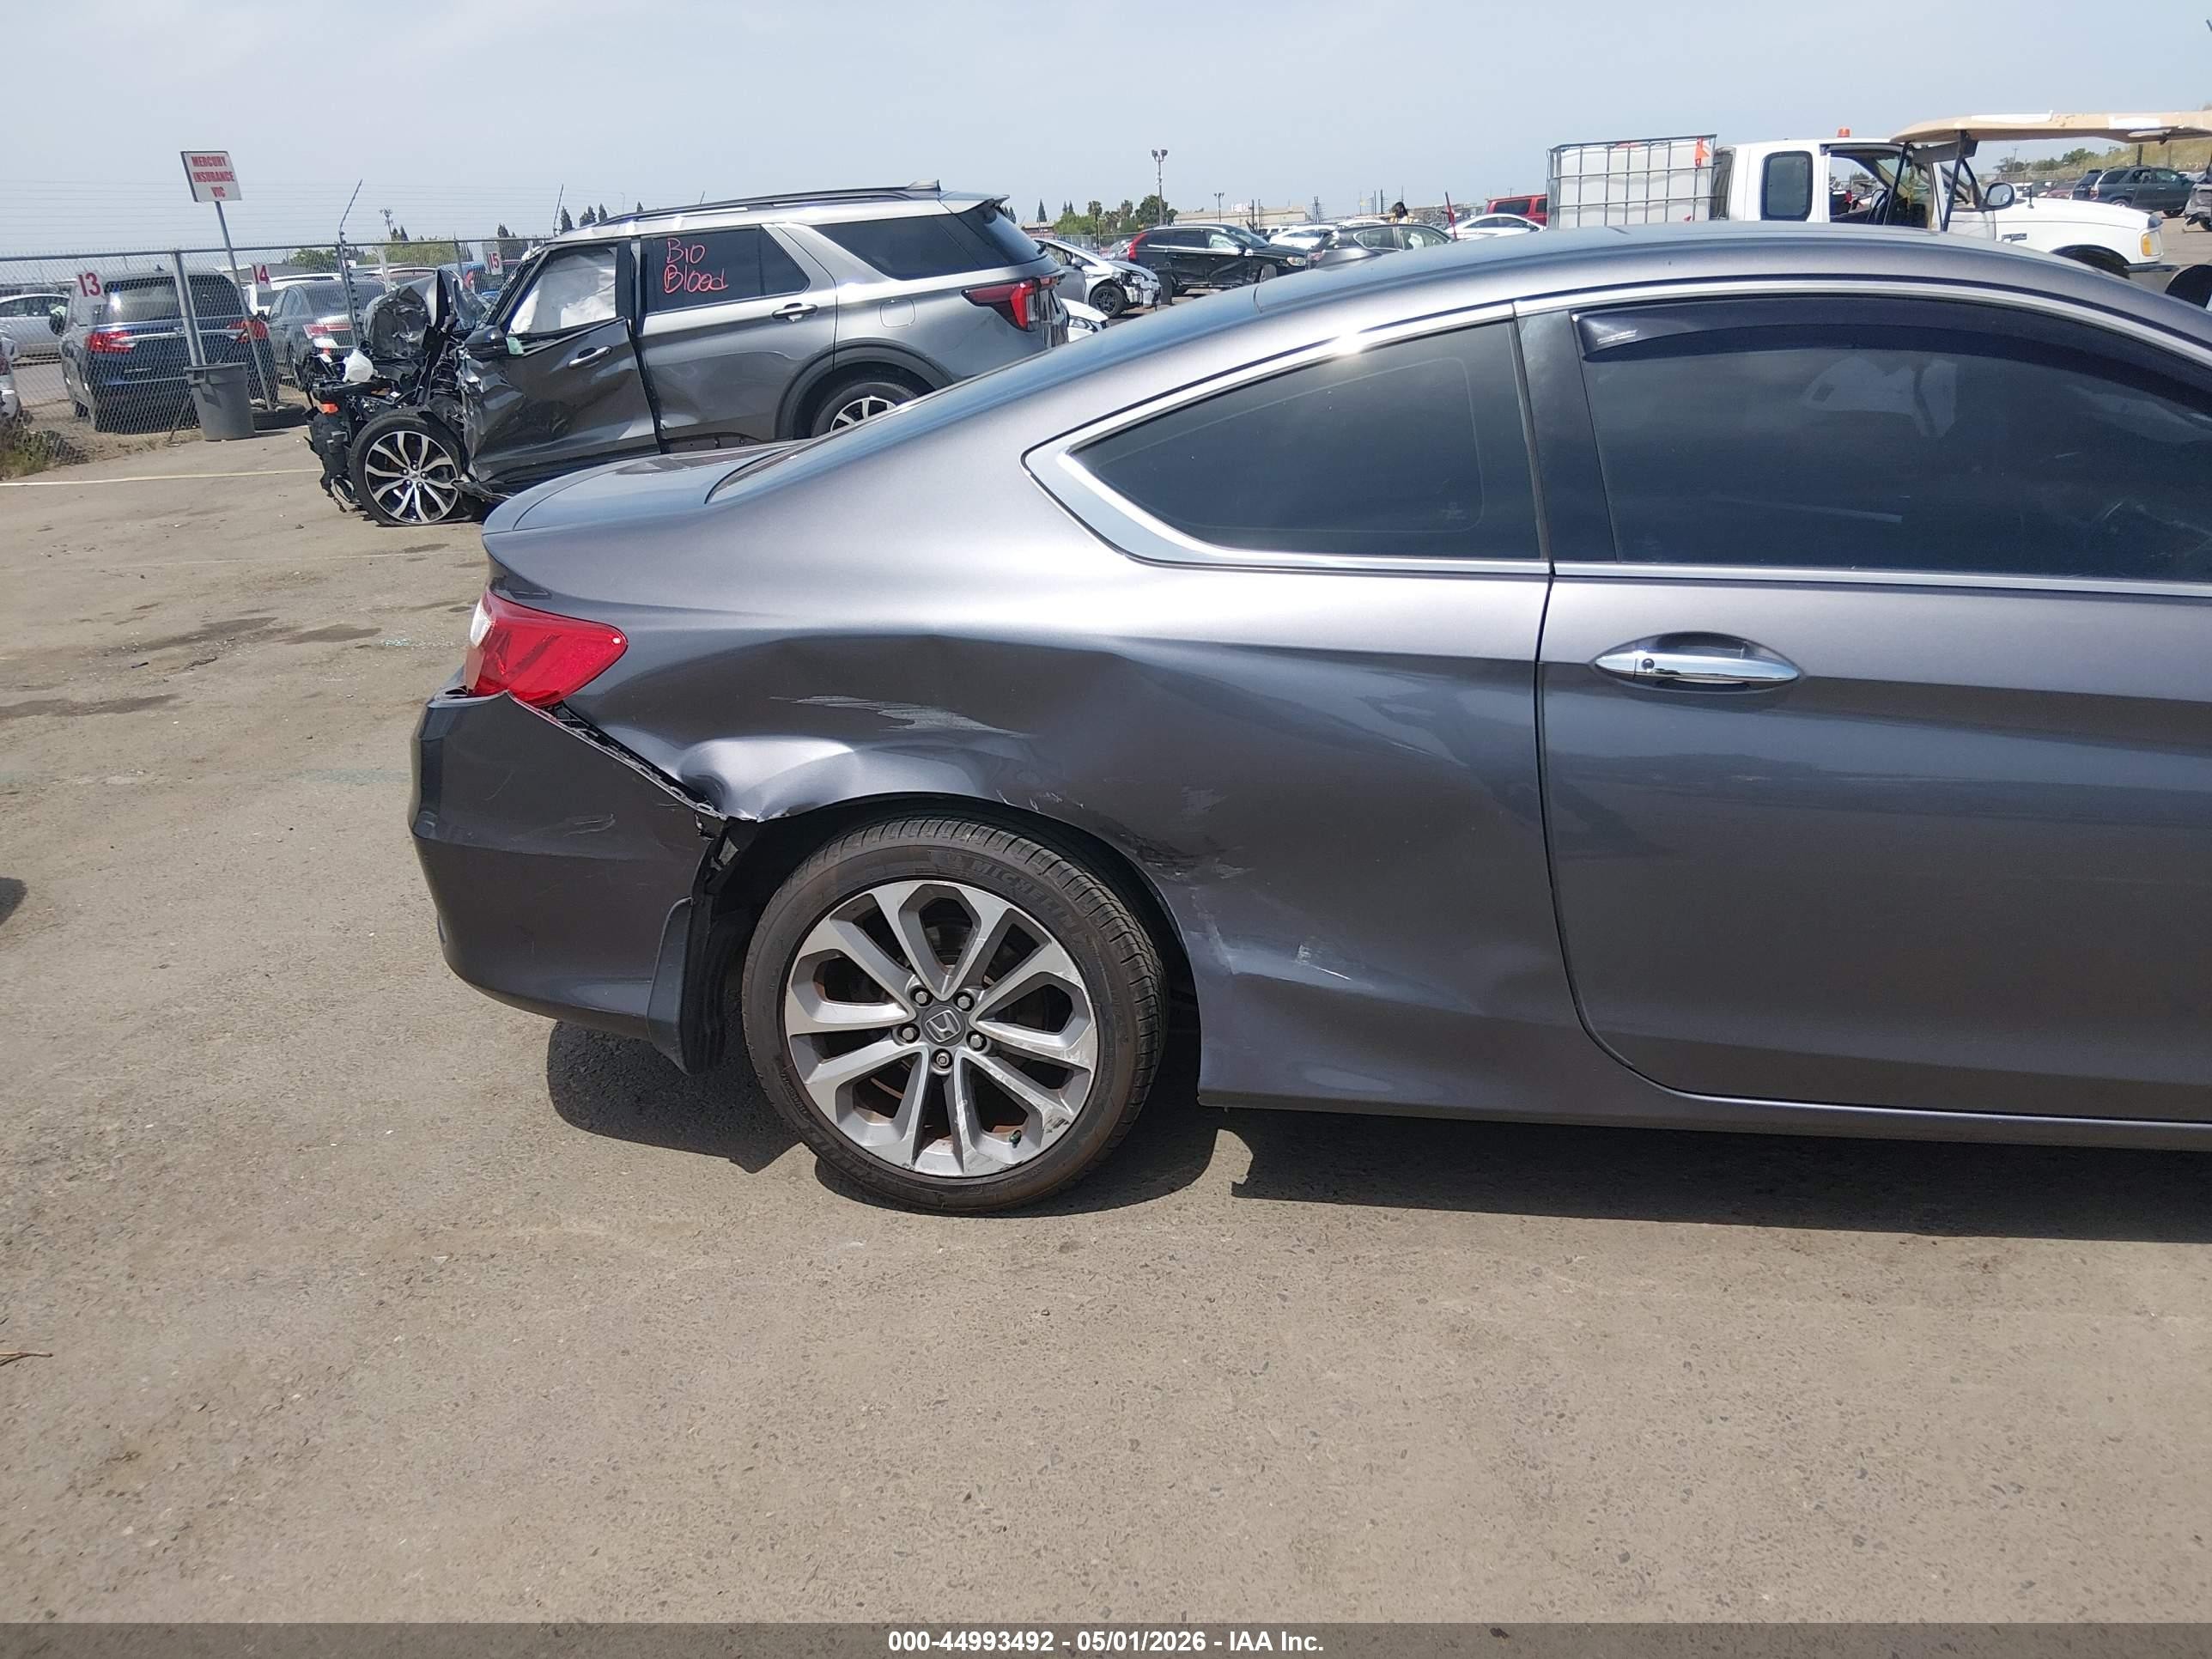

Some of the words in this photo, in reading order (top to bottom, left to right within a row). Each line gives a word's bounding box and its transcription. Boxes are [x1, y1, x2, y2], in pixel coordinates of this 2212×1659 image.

[191, 155, 228, 167] MERCURY
[192, 171, 234, 182] INSURANCE
[489, 252, 500, 270] 15
[252, 264, 270, 284] 14
[664, 264, 729, 294] Blood
[78, 272, 100, 297] 13
